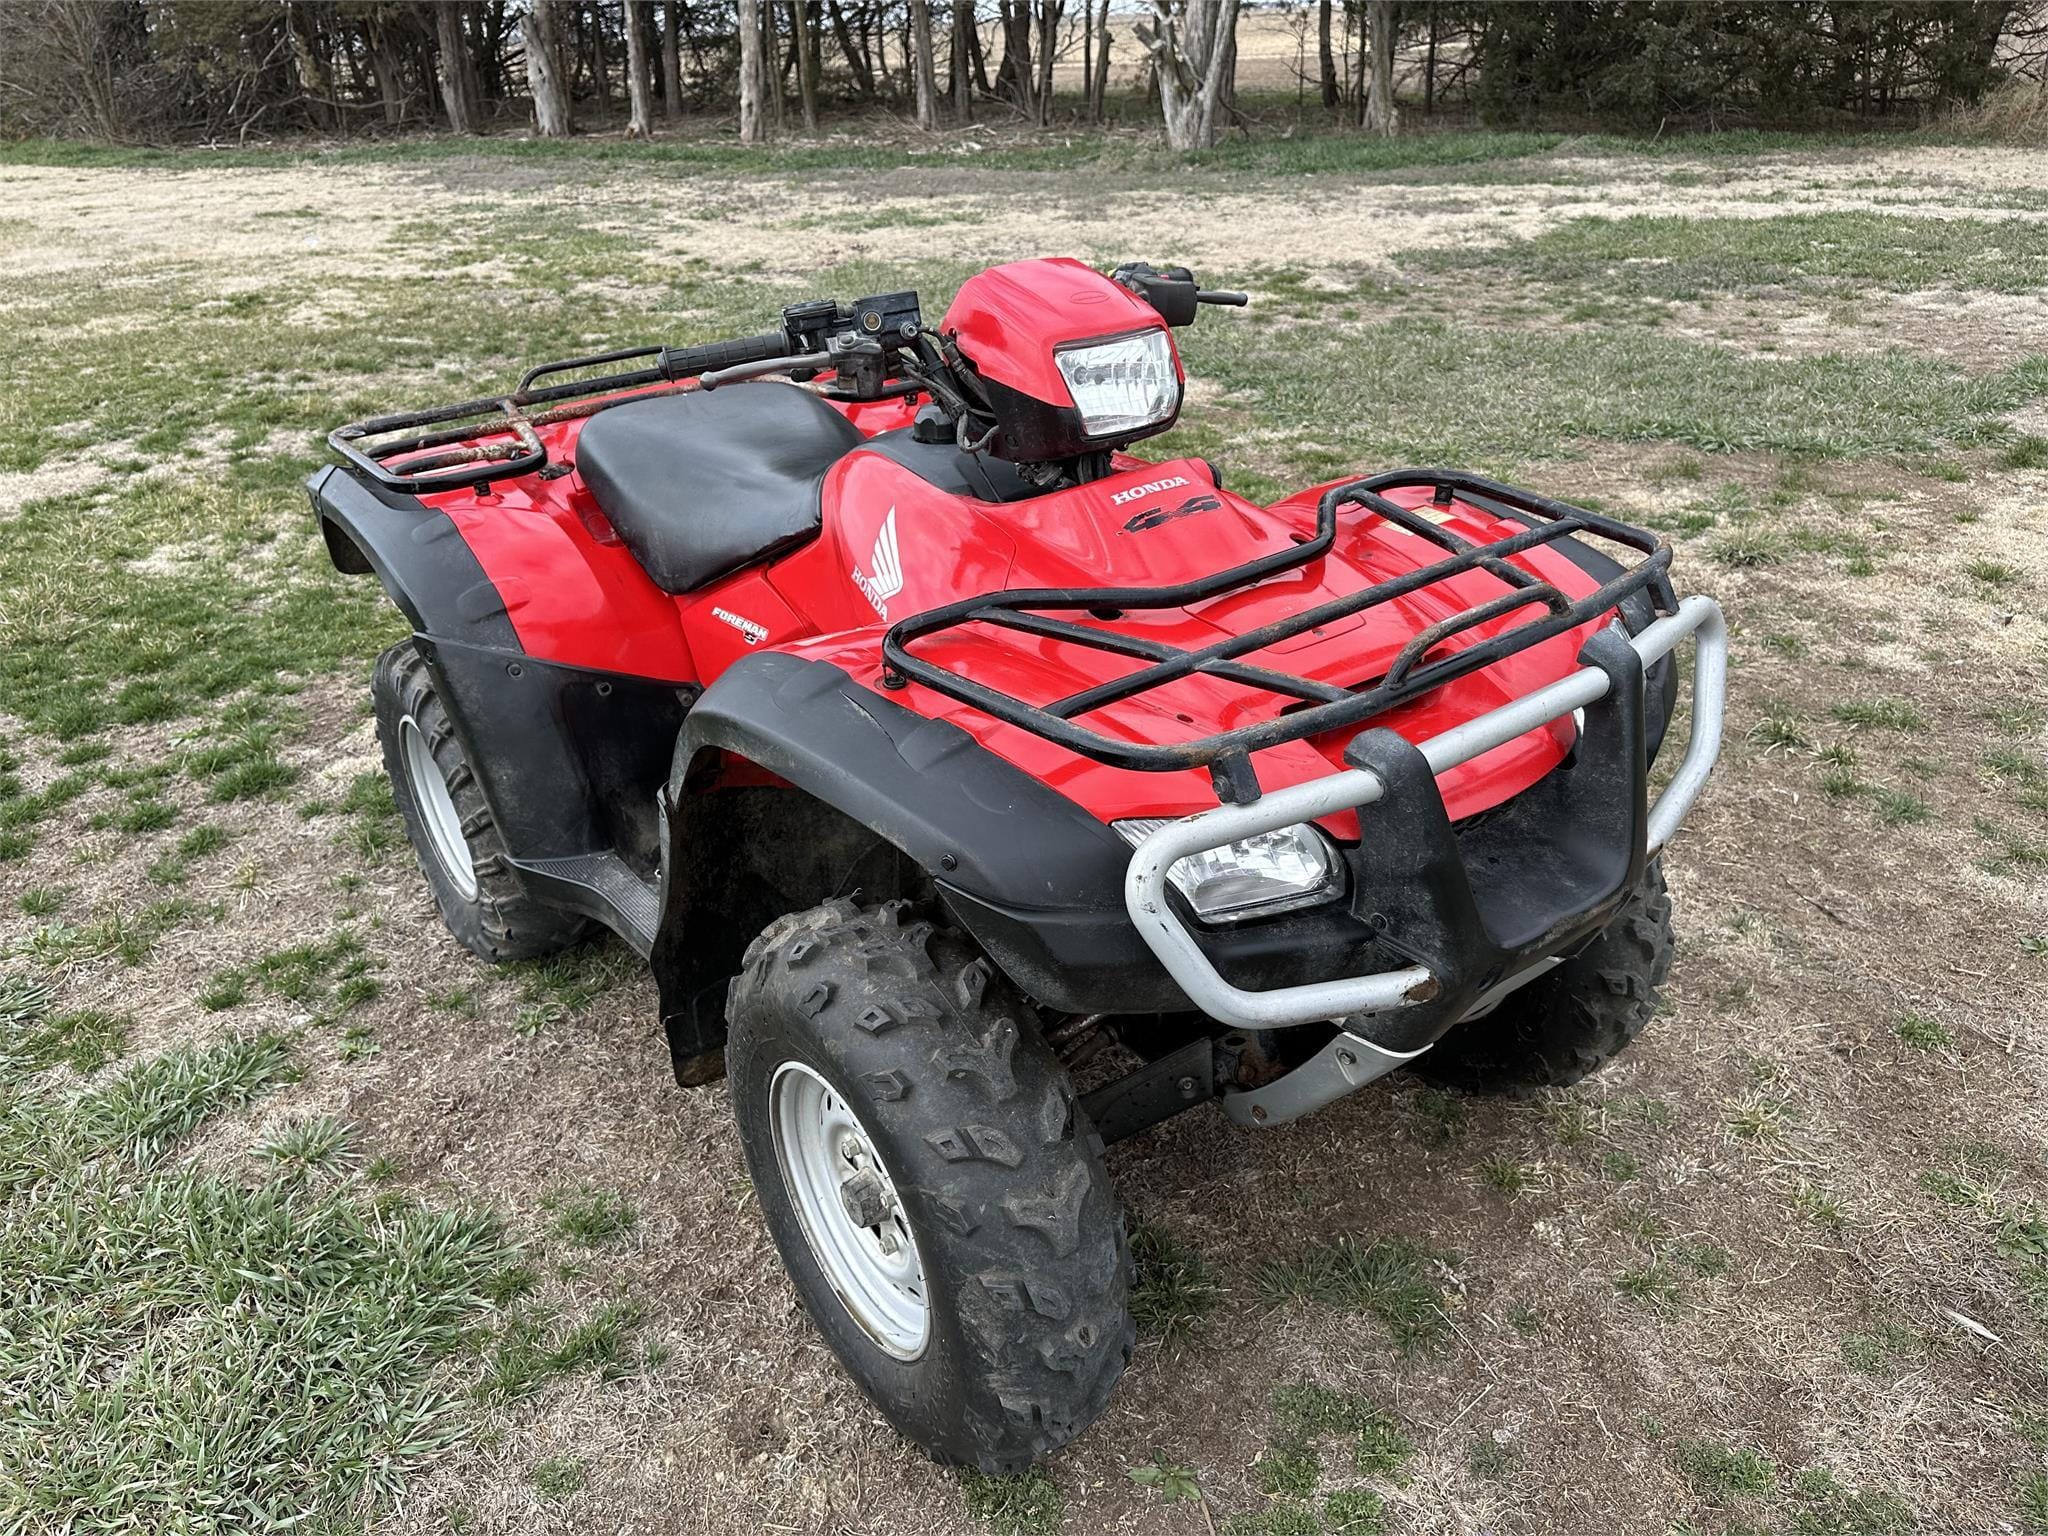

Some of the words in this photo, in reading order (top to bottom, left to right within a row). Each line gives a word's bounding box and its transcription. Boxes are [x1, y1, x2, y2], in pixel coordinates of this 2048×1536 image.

[1110, 476, 1190, 506] HONDA
[851, 564, 888, 622] HONDA
[712, 606, 769, 642] FOREMAN
